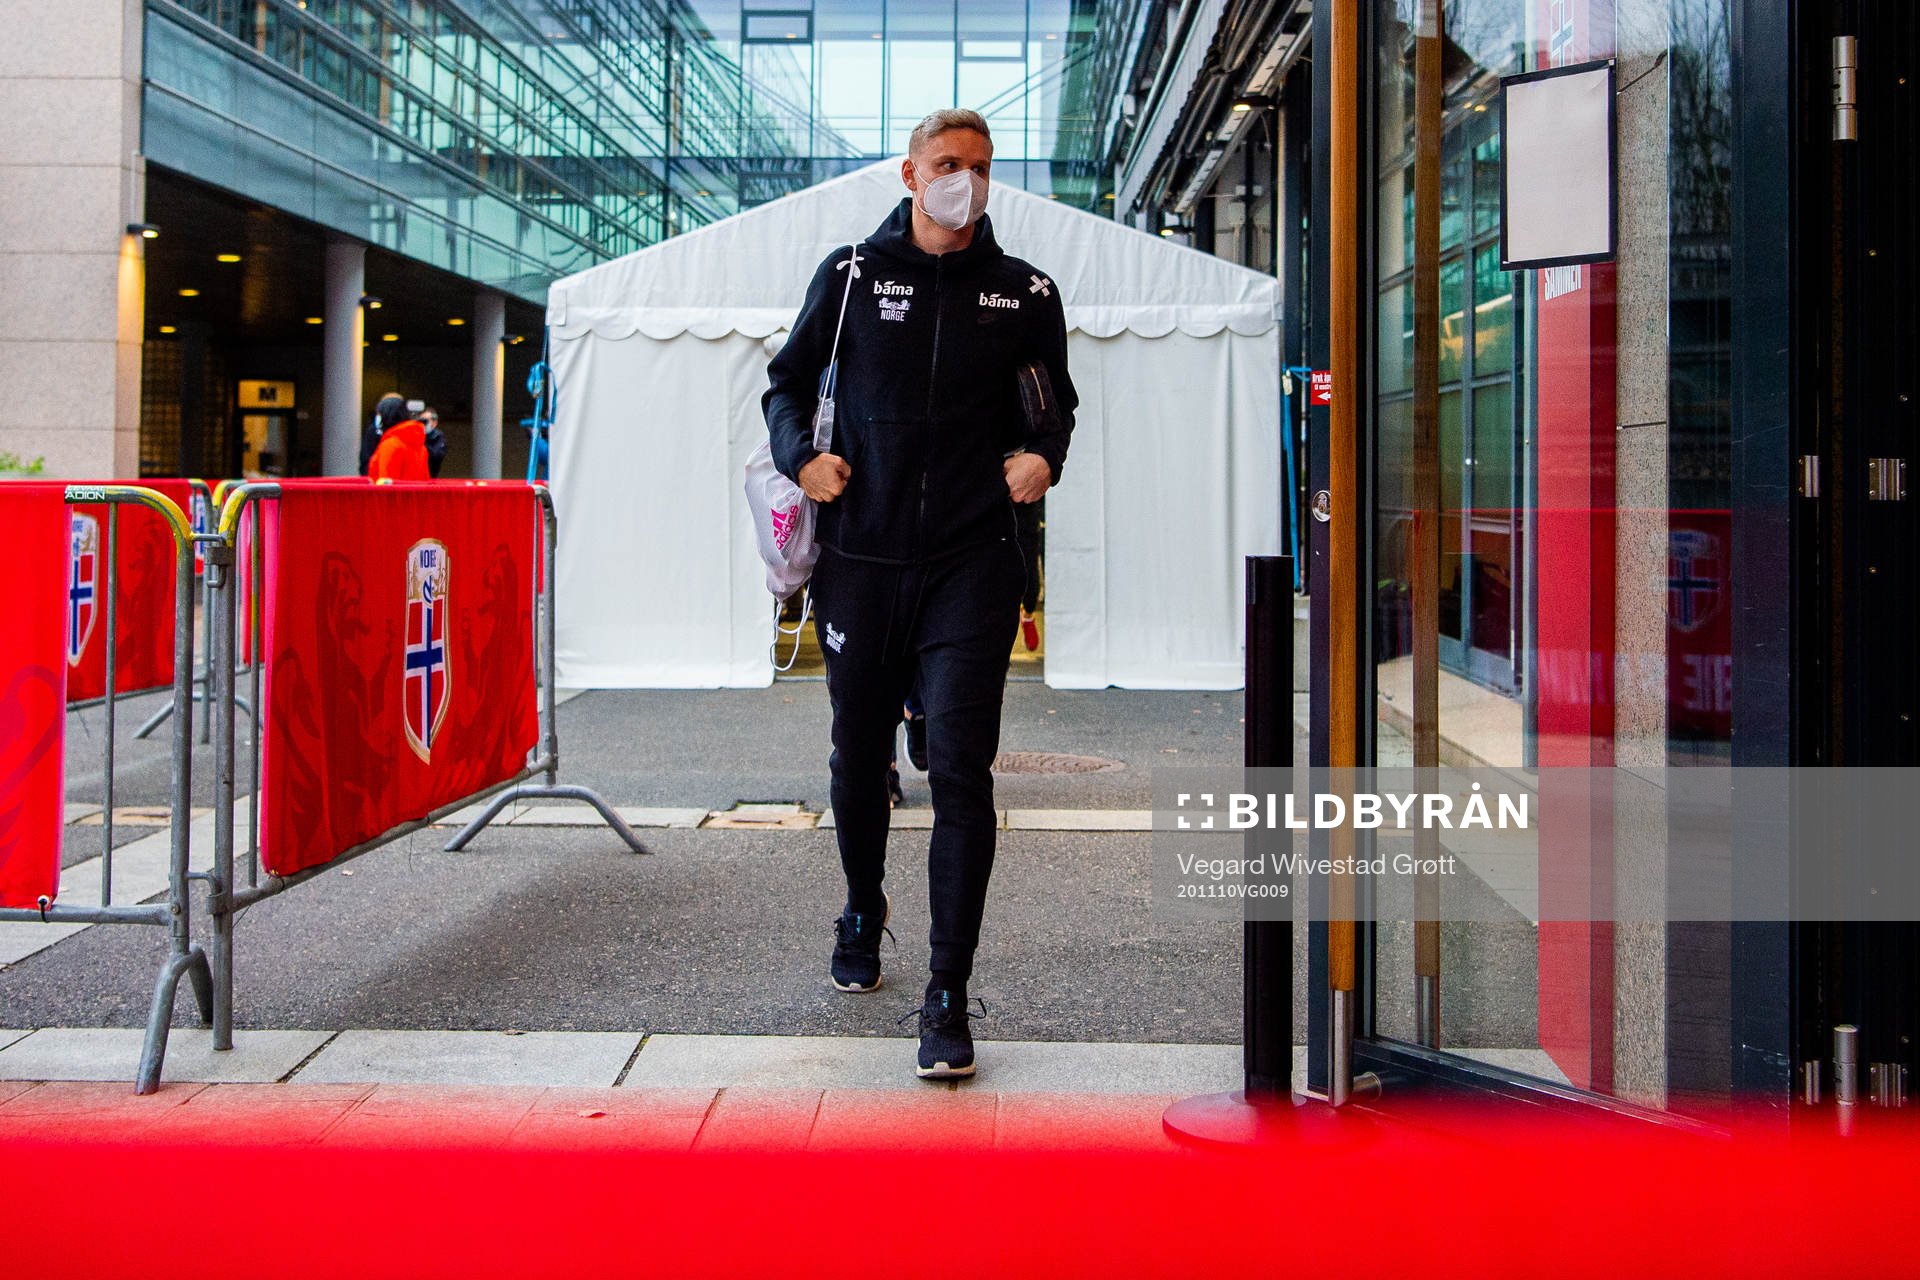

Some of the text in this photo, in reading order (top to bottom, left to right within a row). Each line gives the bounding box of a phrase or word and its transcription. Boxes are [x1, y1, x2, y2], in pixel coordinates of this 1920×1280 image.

[880, 309, 906, 322] NORGE
[259, 387, 277, 401] M
[65, 491, 105, 500] ADION
[775, 504, 799, 551] adidas
